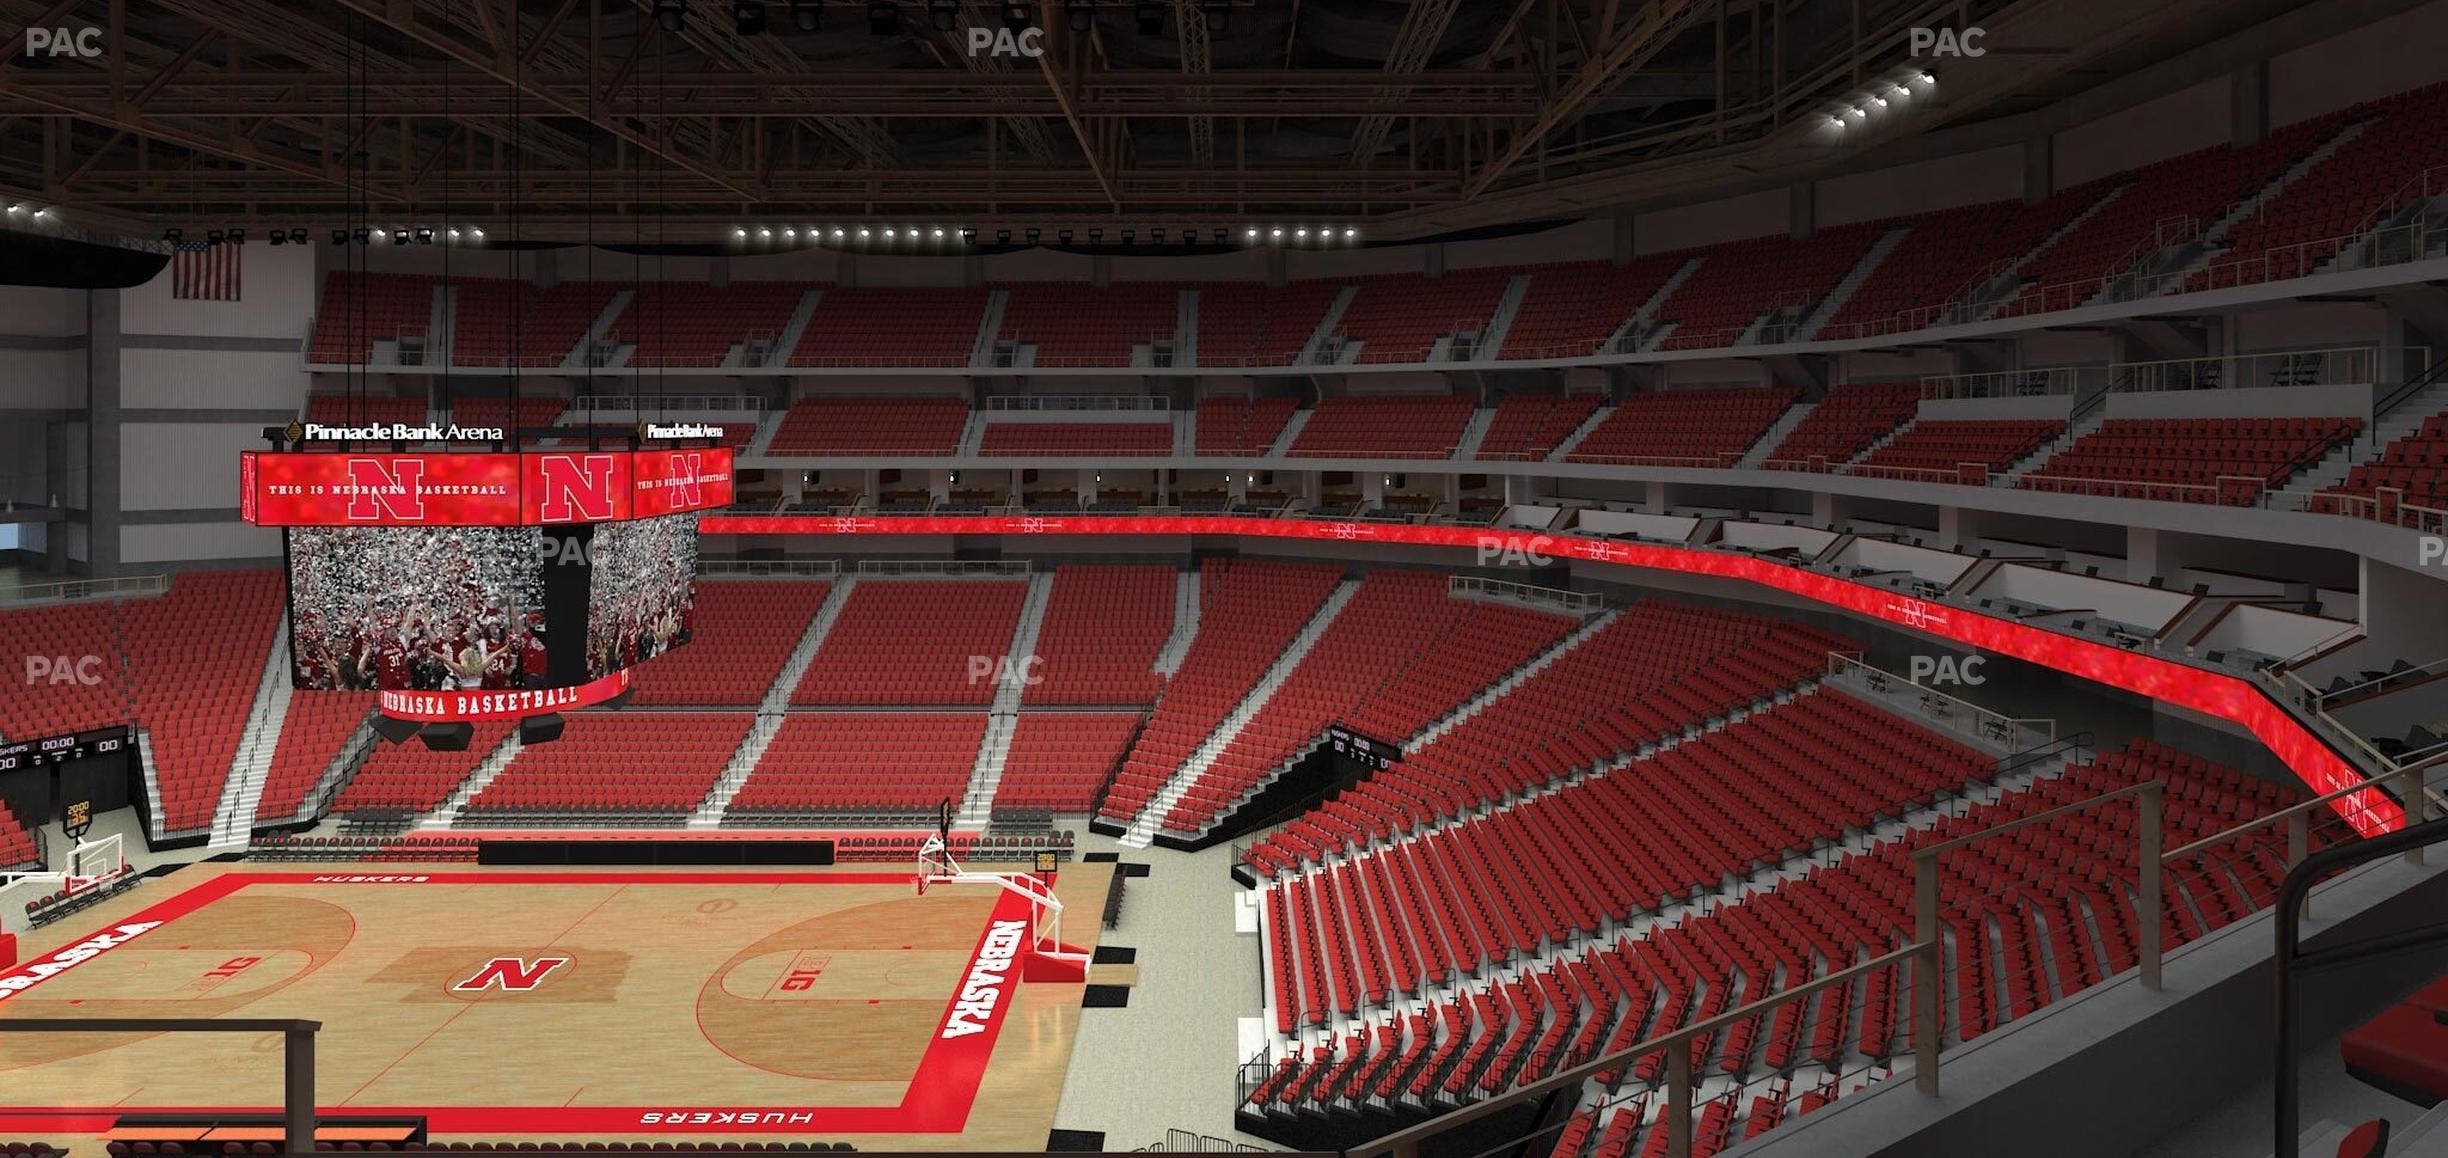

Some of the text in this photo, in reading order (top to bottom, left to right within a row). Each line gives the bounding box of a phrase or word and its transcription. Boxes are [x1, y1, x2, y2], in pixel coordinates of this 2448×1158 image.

[305, 422, 504, 440] Pinnacle Bank Arena
[269, 485, 506, 495] THIS IS NEBRASKA BASKETBALL
[349, 459, 424, 520] N
[541, 455, 613, 522] N
[383, 686, 577, 715] NEBRASKA BASKETBALL
[42, 737, 75, 751] 00:00
[99, 740, 118, 752] 00
[313, 875, 430, 883] HUSKERS
[452, 957, 570, 991] N
[941, 920, 1028, 1039] NEBRASKA
[640, 1112, 814, 1124] HUSKERS
